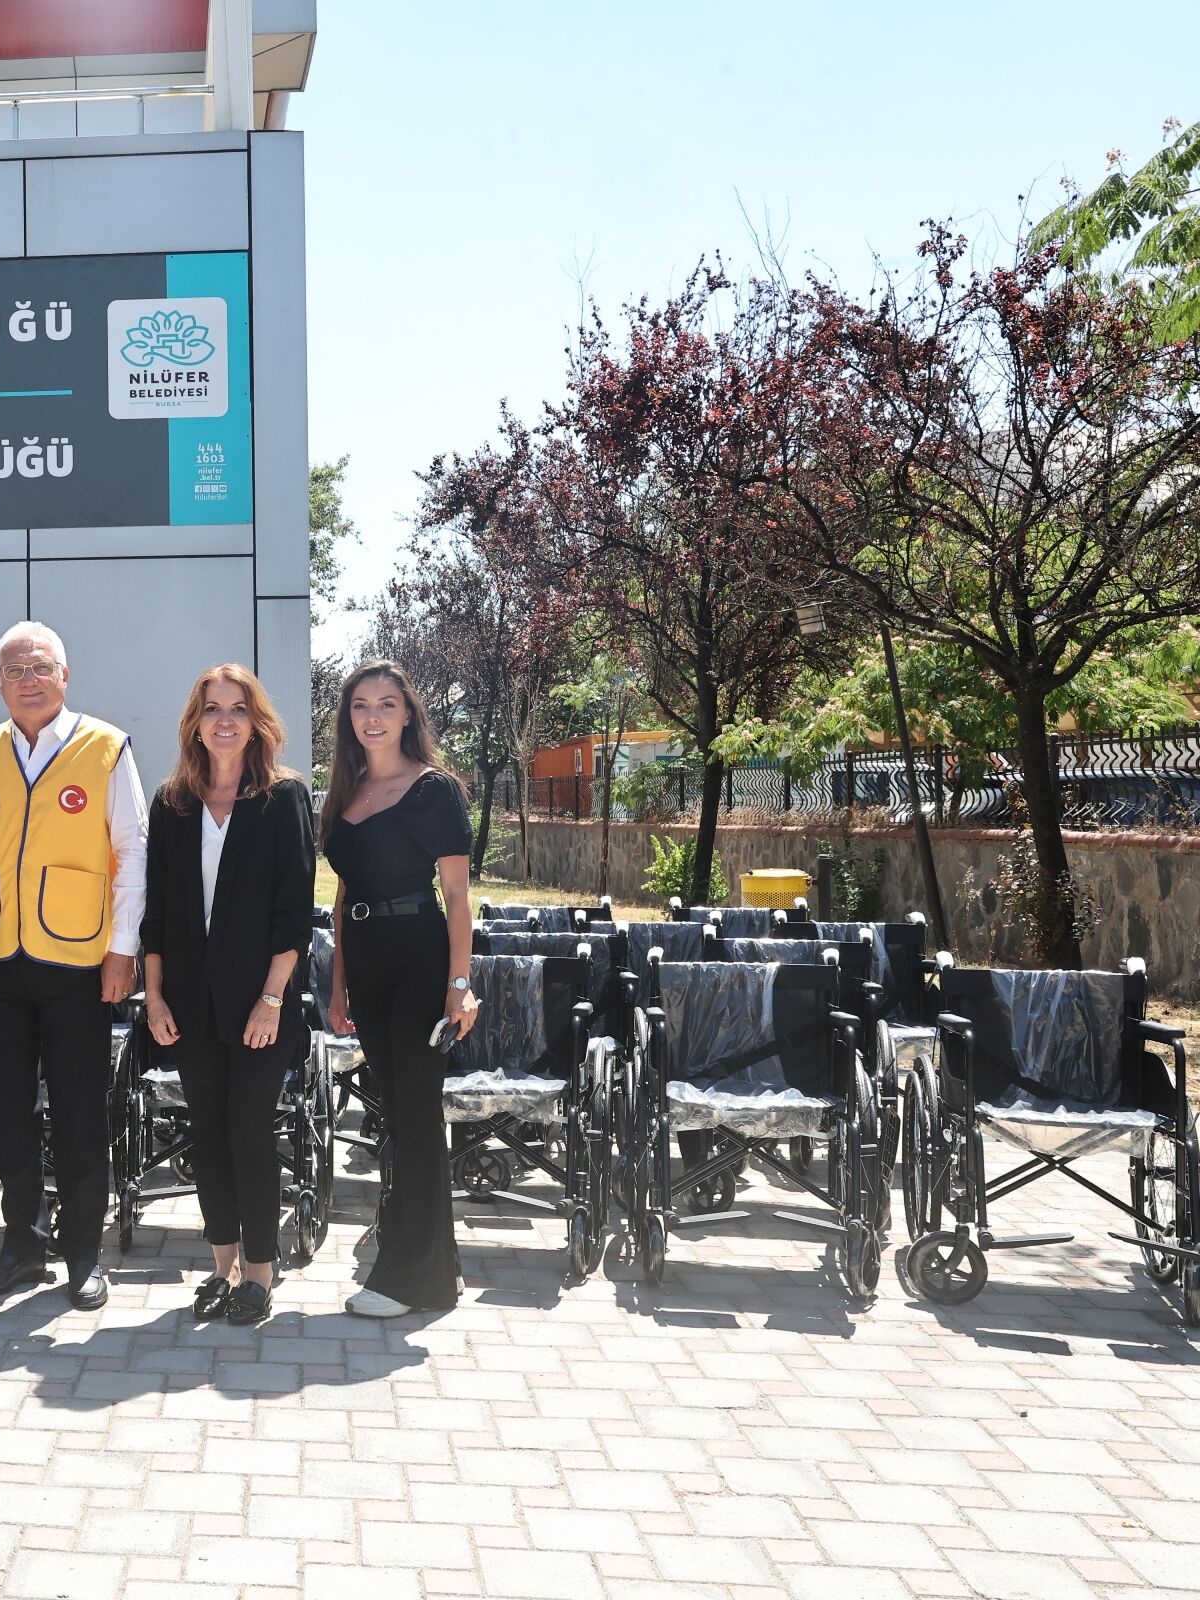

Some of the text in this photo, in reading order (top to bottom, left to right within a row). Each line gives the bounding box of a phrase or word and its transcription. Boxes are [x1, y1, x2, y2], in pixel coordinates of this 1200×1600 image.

[129, 369, 210, 384] NİLÜFER
[129, 386, 208, 398] BELEDİYESİ
[198, 443, 222, 454] 444
[196, 452, 225, 463] 1603
